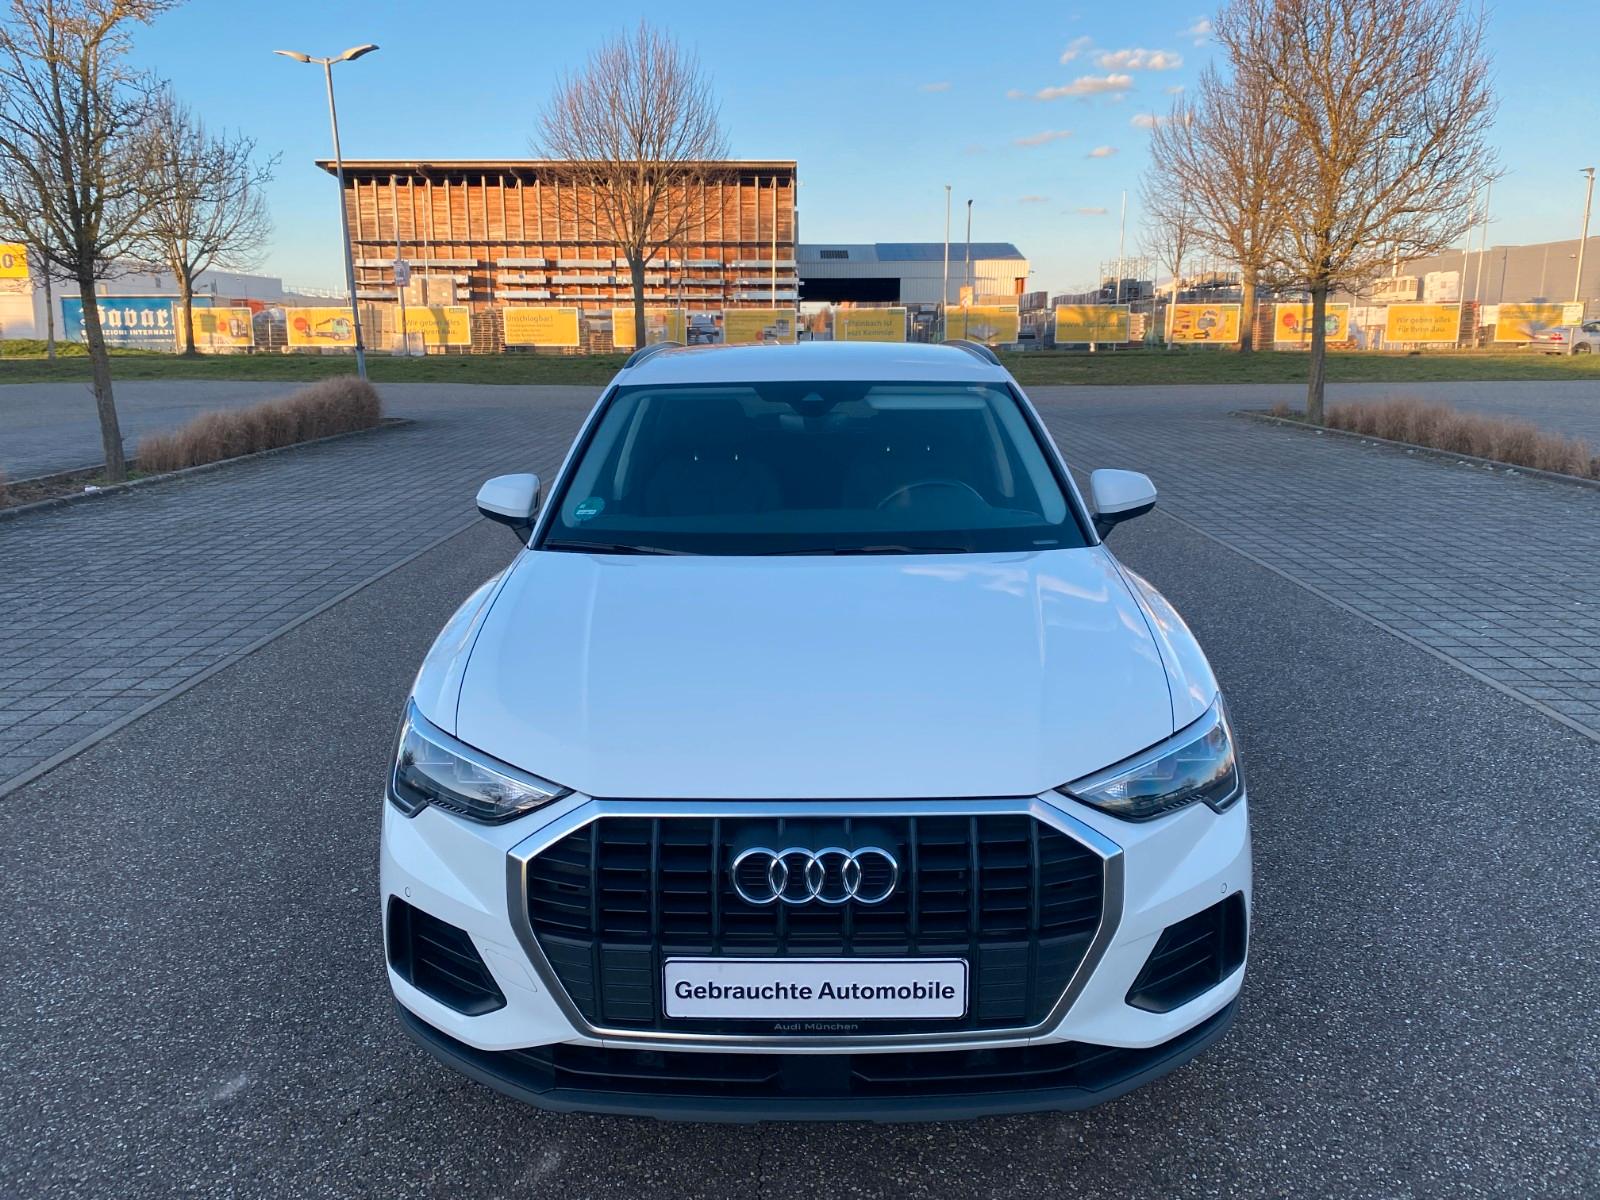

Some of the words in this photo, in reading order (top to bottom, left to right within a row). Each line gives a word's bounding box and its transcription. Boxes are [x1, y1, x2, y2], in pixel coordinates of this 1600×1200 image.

[674, 981, 813, 1000] Gebrauchte
[818, 981, 956, 1000] Automobile
[774, 1023, 801, 1031] Audi
[804, 1023, 859, 1031] München
